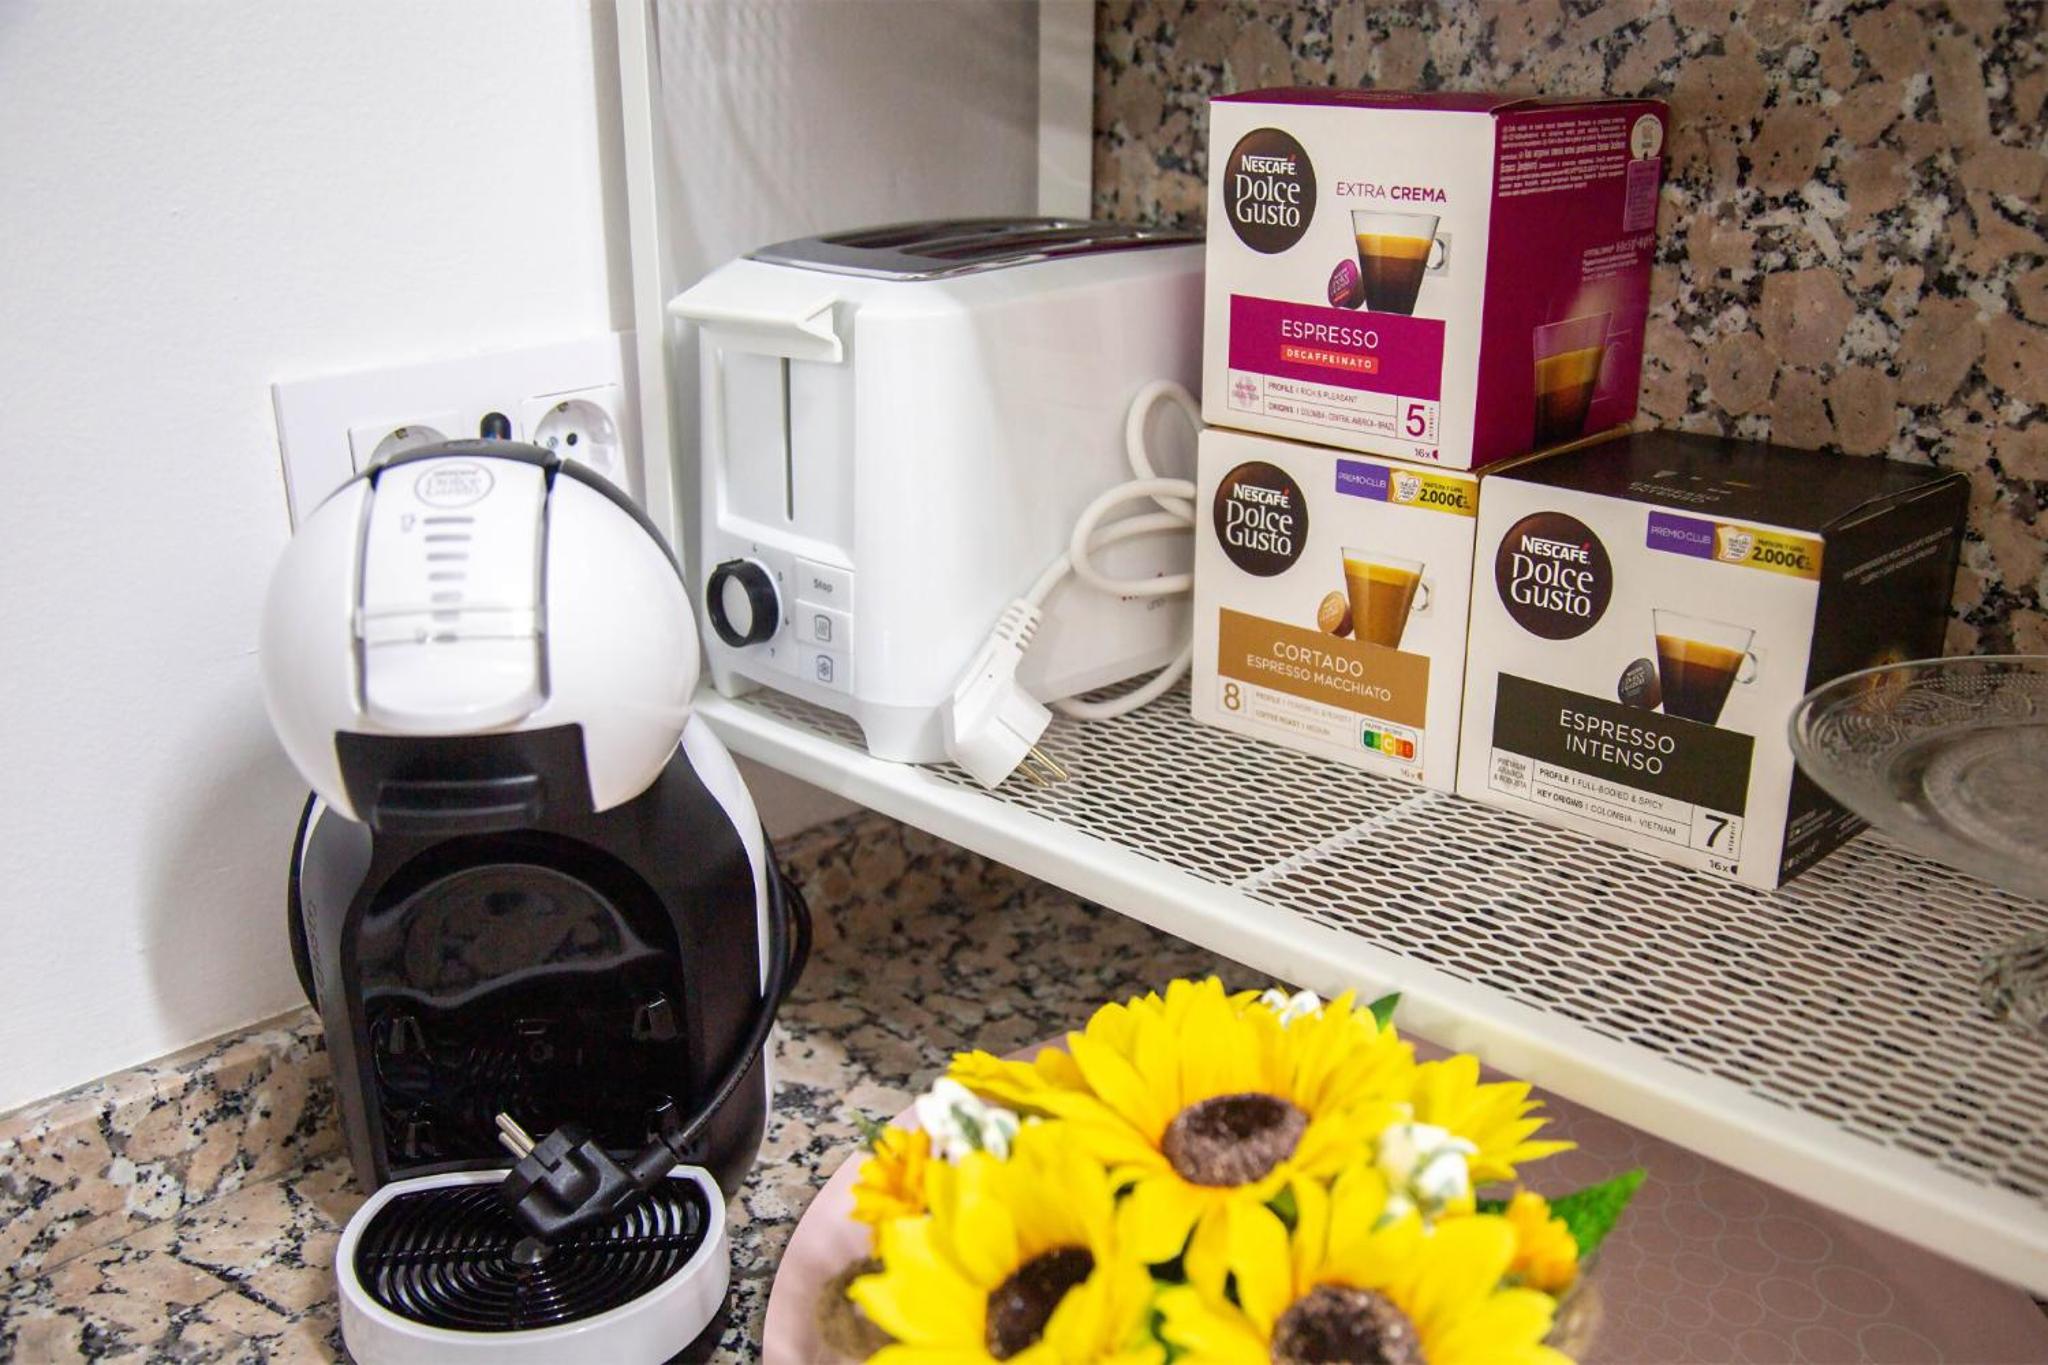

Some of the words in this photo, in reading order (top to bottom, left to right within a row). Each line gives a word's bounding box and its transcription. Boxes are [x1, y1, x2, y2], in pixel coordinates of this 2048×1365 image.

[1235, 174, 1300, 204] Dolce
[1336, 181, 1386, 199] EXTRA
[1390, 186, 1447, 203] CREMA
[1235, 198, 1300, 228] Gusto
[1281, 319, 1379, 349] ESPRESSO
[1286, 348, 1373, 369] DECAFFEINATO
[1406, 404, 1426, 437] 5
[1226, 499, 1294, 536] Dolce
[1226, 521, 1292, 557] Gusto
[813, 578, 833, 594] Stop
[1511, 553, 1595, 594] Dolce
[1510, 577, 1591, 618] Gusto
[1273, 641, 1364, 677] CORTADO
[1247, 654, 1311, 681] ESPRESSO
[1314, 673, 1391, 702] MACCHIATO
[1224, 682, 1241, 711] 8
[1559, 709, 1675, 754] ESPRESSO
[1566, 733, 1663, 775] INTENSO
[1539, 768, 1570, 786] PROFILE
[1639, 796, 1664, 810] SPICY
[1537, 788, 1553, 799] KEY
[1553, 792, 1584, 809] ORIGINS
[1590, 804, 1632, 823] COLOMBIA
[1639, 818, 1677, 837] VIETNAM
[1705, 814, 1729, 848] 7
